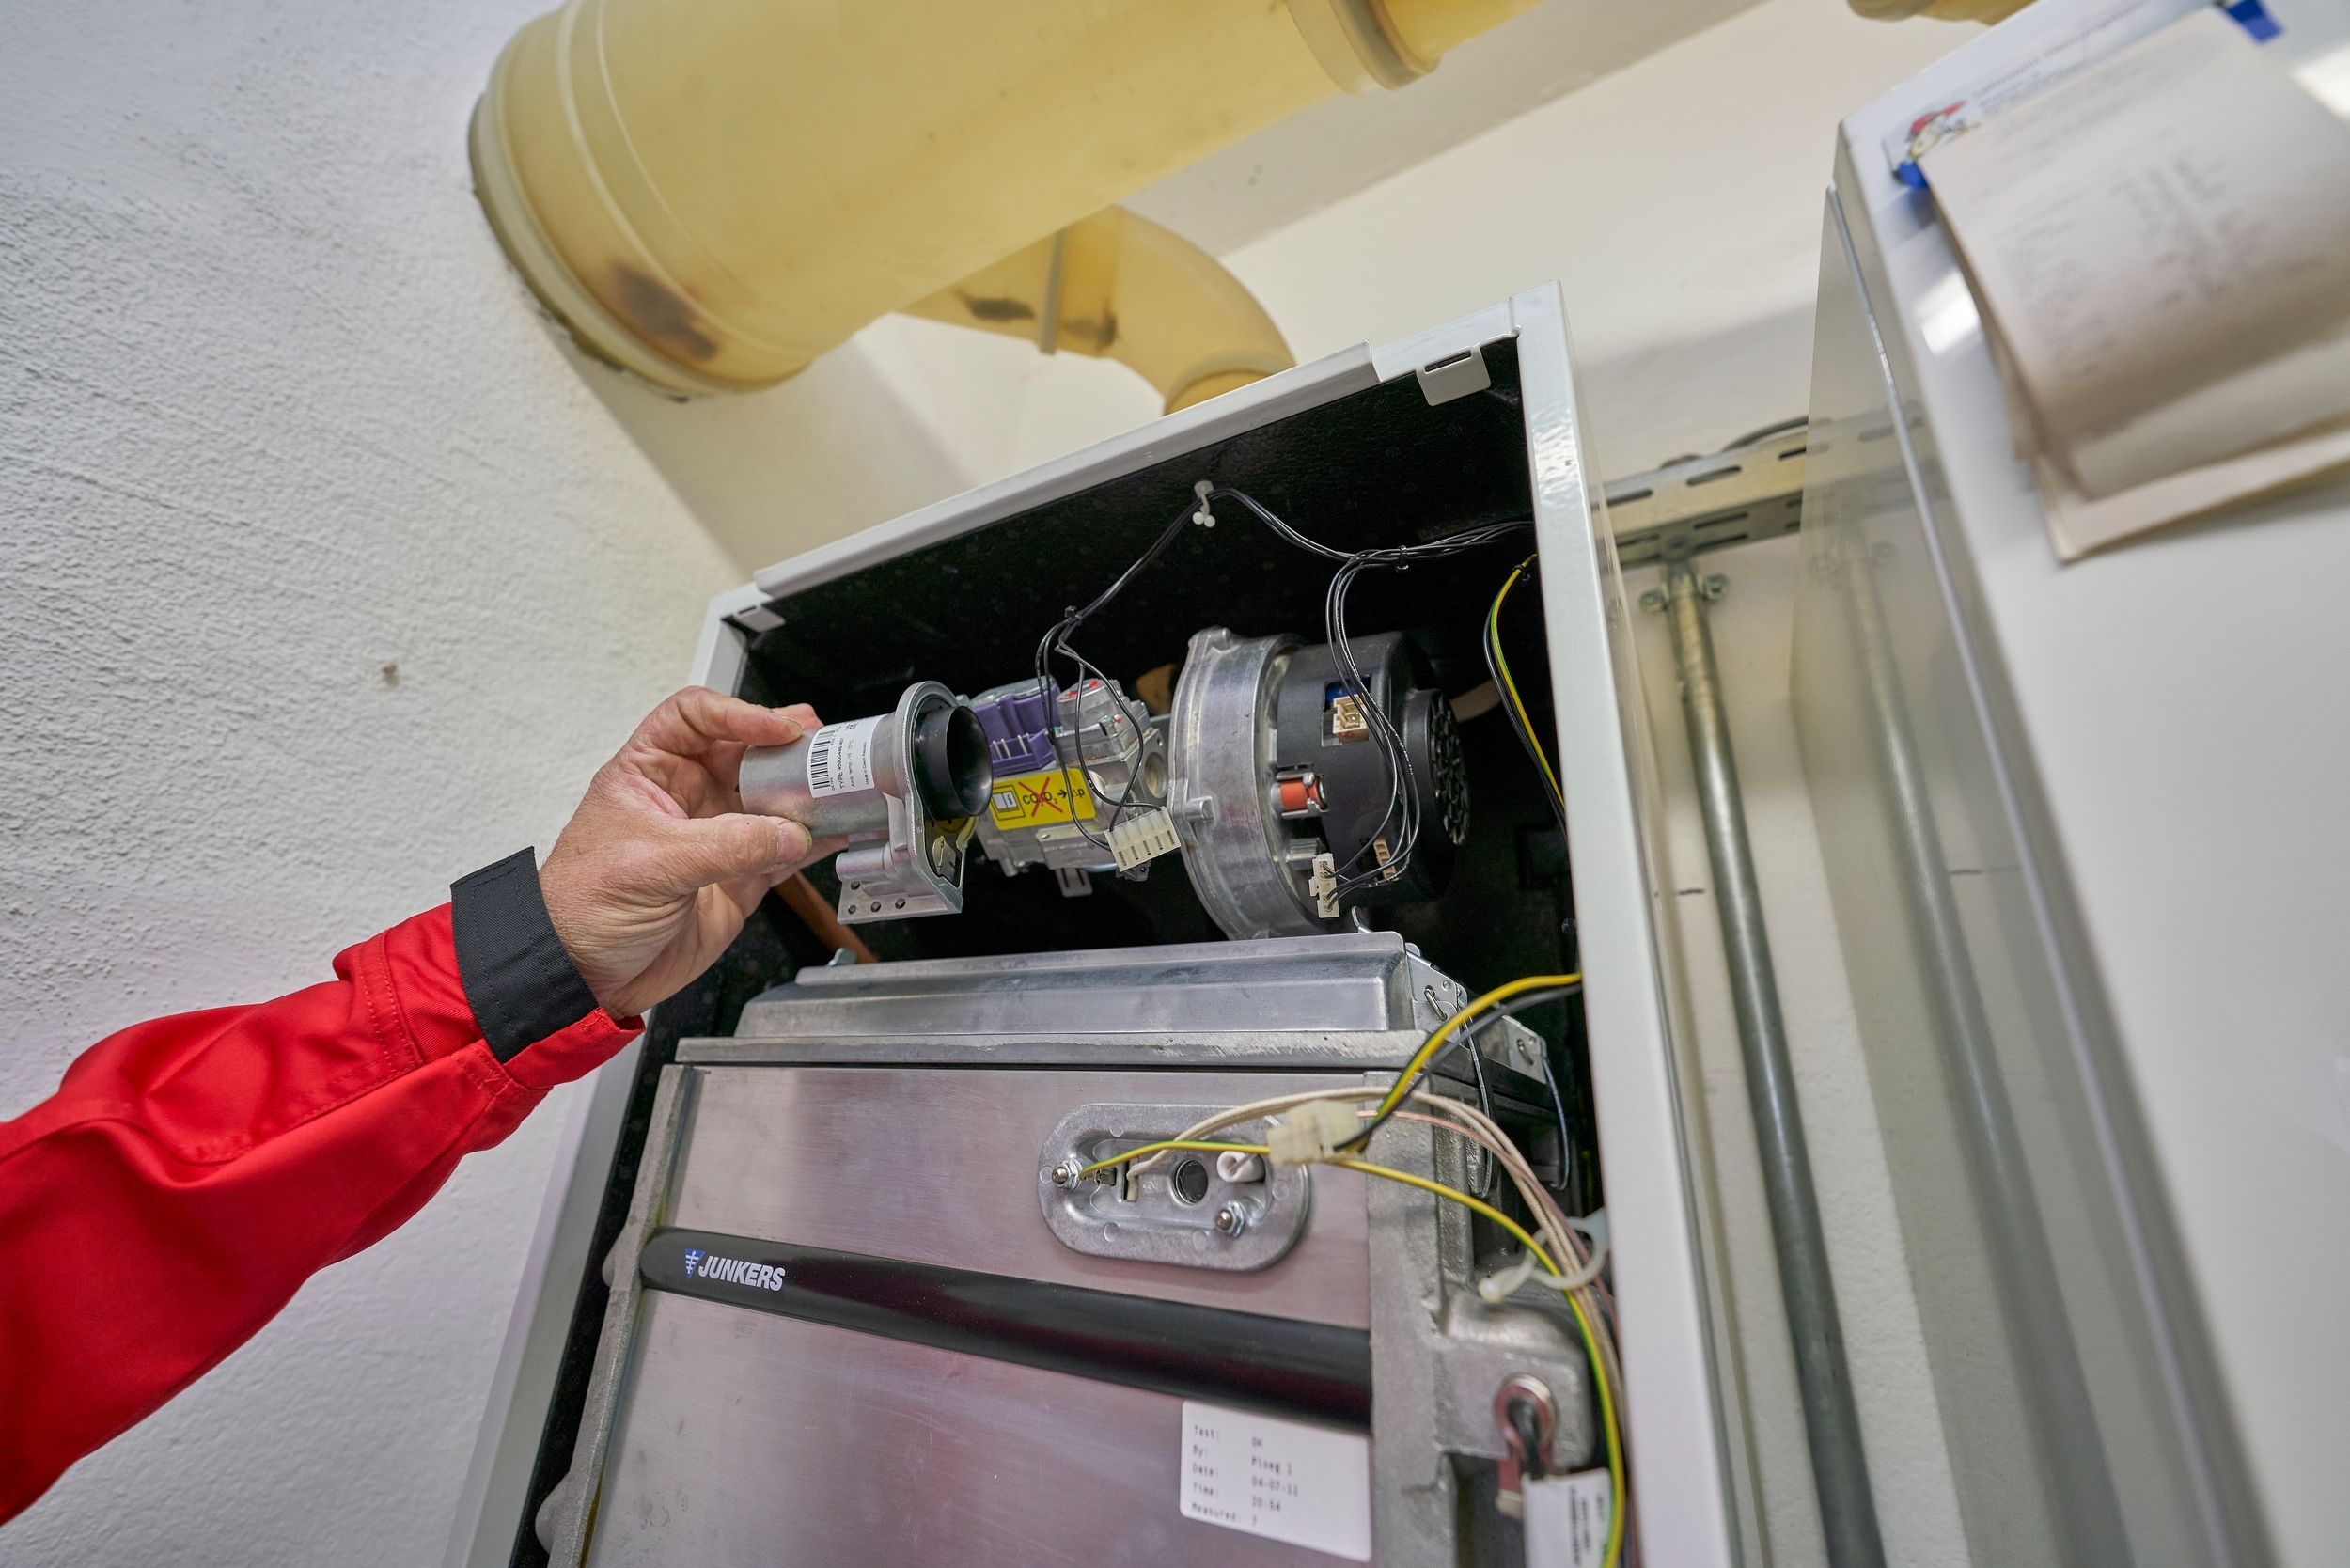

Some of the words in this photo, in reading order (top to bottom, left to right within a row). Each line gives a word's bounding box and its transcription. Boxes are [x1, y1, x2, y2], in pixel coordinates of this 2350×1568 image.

[697, 1255, 787, 1292] JUNKERS
[1193, 1425, 1220, 1440] Test:
[1252, 1436, 1264, 1448] OK
[1192, 1443, 1208, 1458] By:
[1191, 1462, 1220, 1480] Date:
[1192, 1481, 1220, 1499] Time:
